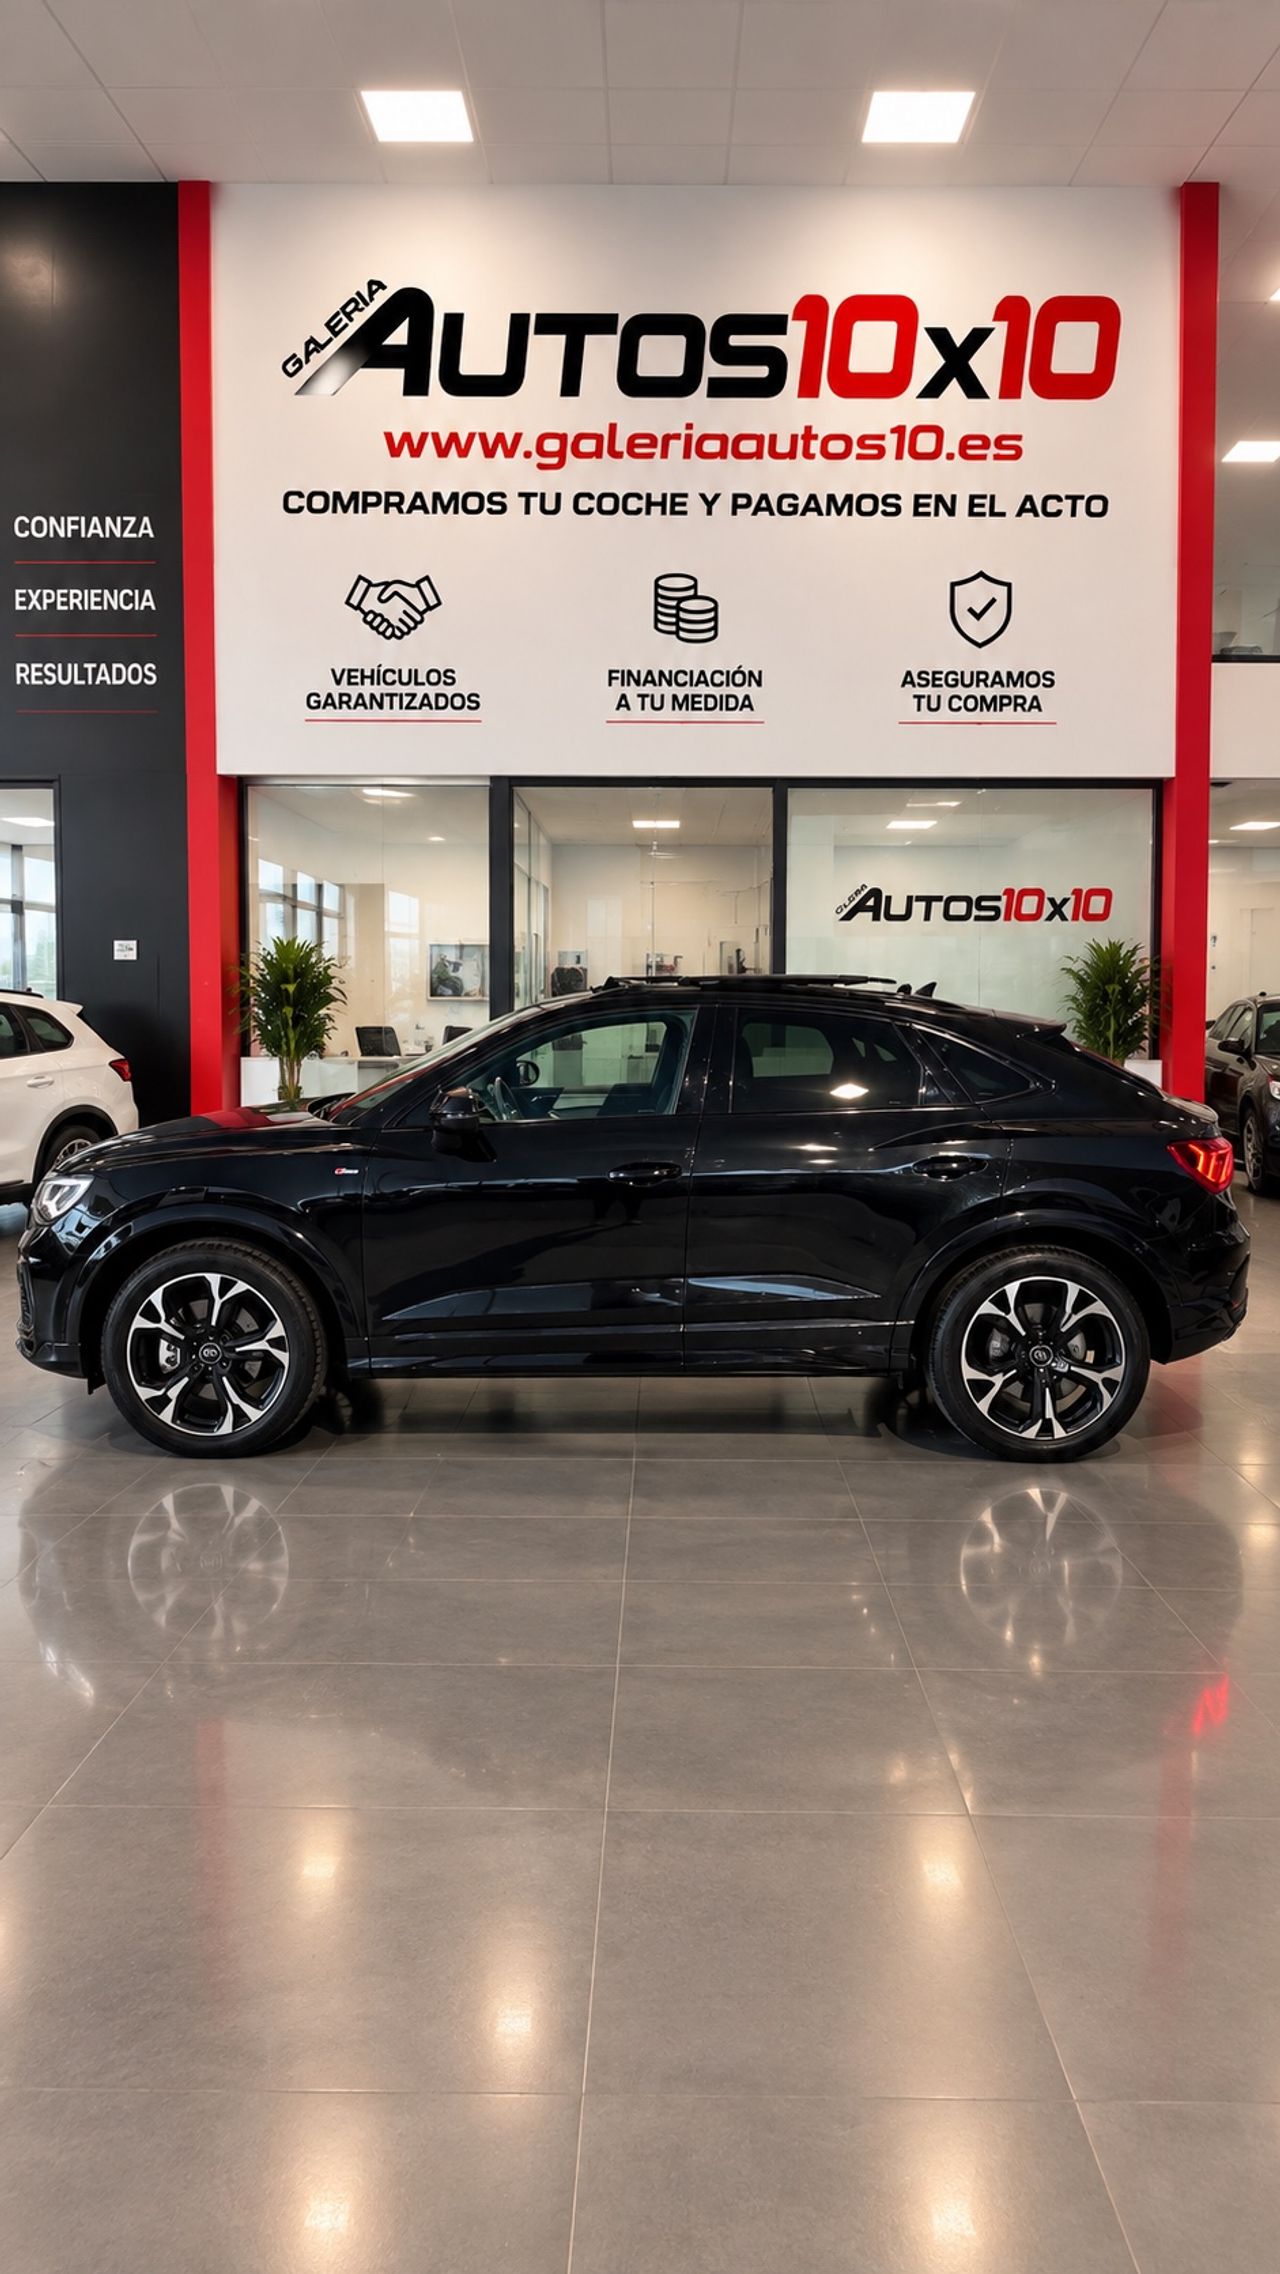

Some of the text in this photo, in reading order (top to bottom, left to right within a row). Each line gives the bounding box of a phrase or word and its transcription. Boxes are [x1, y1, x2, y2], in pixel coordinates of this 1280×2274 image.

[281, 279, 388, 379] GALERIA
[383, 423, 1024, 471] www.galeriaautos10.es
[282, 490, 1110, 519] COMPRAMOS TU COCHE Y PAGAMOS EN EL ACTO
[13, 515, 155, 539] CONFIANZA
[14, 588, 156, 611] EXPERIENCIA
[15, 662, 158, 686] RESULTADOS
[330, 663, 457, 687] VEHÍCULOS
[607, 664, 763, 688] FINANCIACIÓN
[900, 669, 1056, 689] ASEGURAMOS
[305, 691, 481, 712] GARANTIZADOS
[615, 692, 755, 712] A TU MEDIDA
[912, 693, 1043, 713] TU COMPRA
